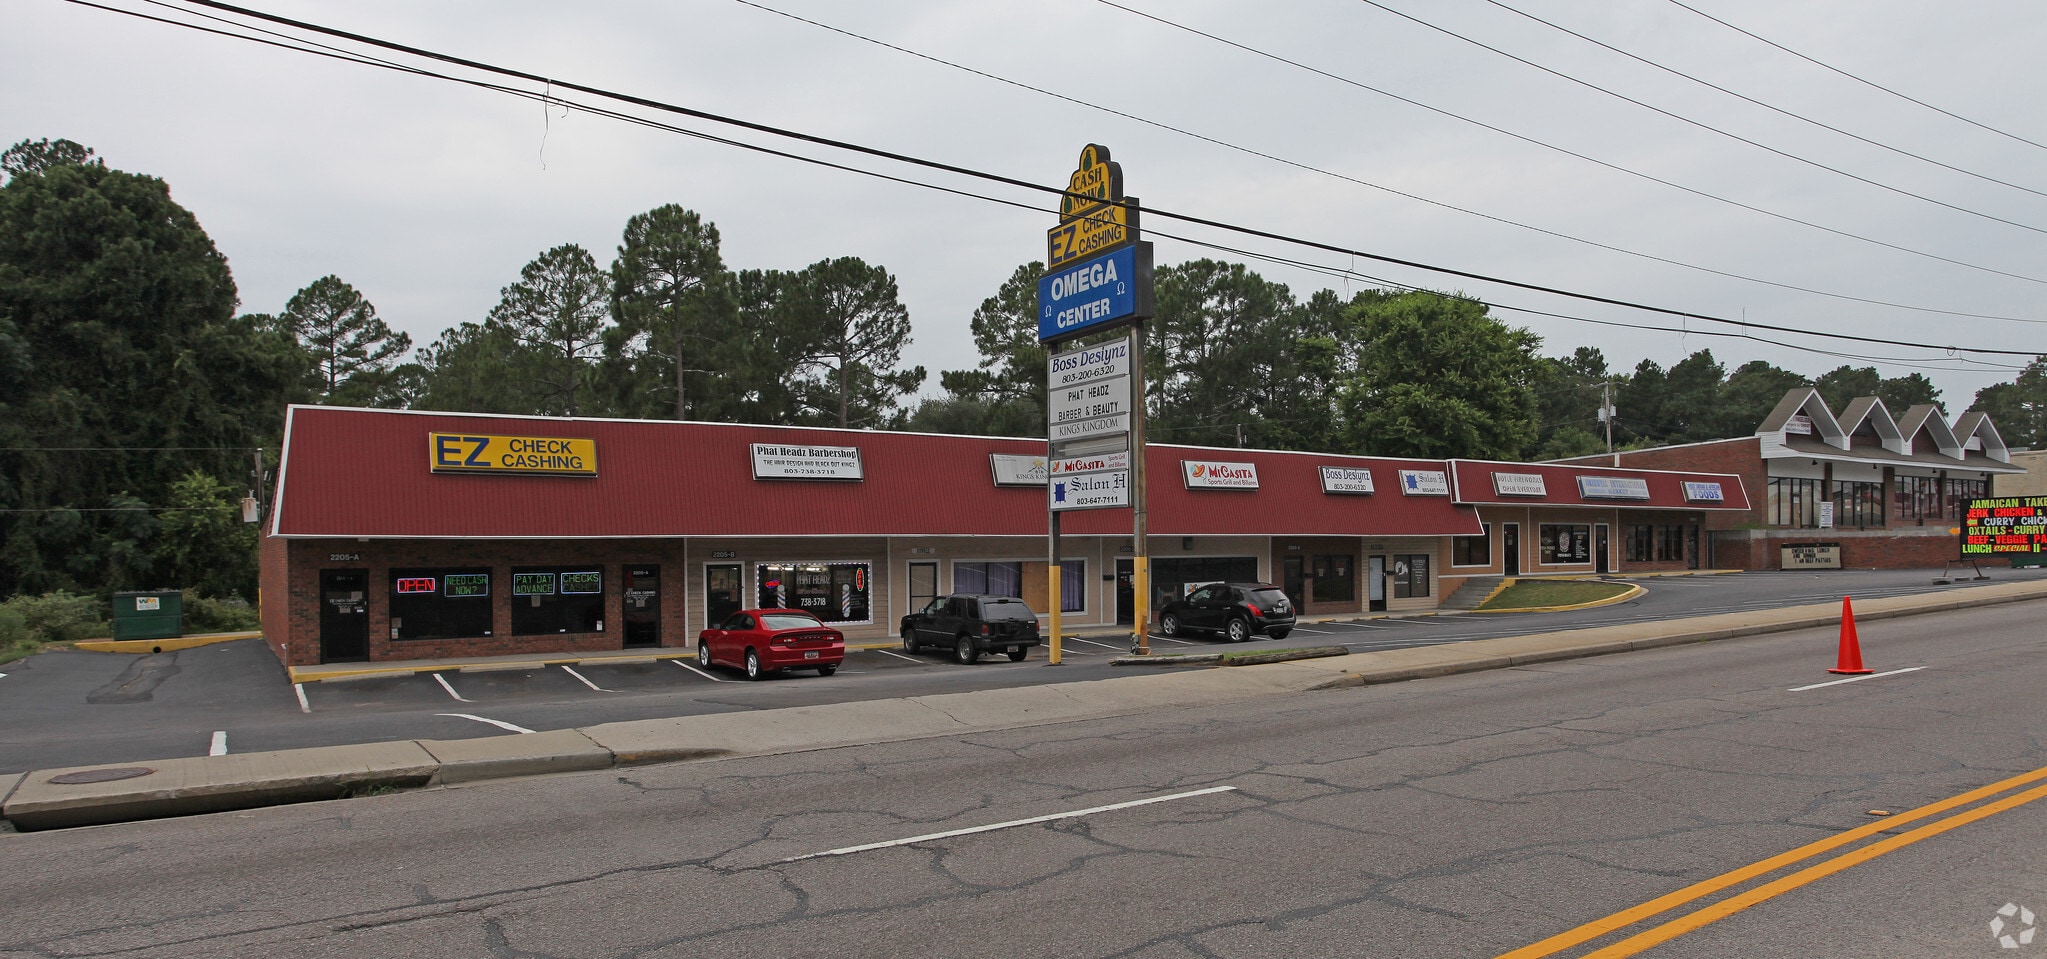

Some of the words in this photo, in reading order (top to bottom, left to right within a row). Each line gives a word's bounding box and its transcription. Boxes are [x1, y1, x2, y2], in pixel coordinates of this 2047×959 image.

[1073, 167, 1103, 191] CASH
[1072, 186, 1098, 211] NOW
[1082, 206, 1117, 234] CHECK
[1050, 225, 1078, 265] EZ
[1079, 225, 1123, 254] CASHING
[1051, 259, 1118, 302] OMEGA
[1057, 297, 1111, 329] CENTER
[1052, 357, 1077, 374] Boss
[1062, 364, 1115, 383] 803-200-6320
[1068, 389, 1084, 402] PHAT
[1088, 385, 1110, 399] HEADZ
[1058, 408, 1082, 421] BARBER
[1085, 406, 1090, 416] &
[1092, 401, 1119, 416] BEAUTY
[1059, 423, 1080, 437] KINGS
[1082, 417, 1119, 433] KINGDOM
[437, 436, 491, 466] EZ
[509, 439, 573, 454] CHECK
[757, 446, 778, 456] Phat
[780, 447, 807, 457] Headz
[809, 448, 857, 459] Barbershop
[501, 454, 583, 469] CASHING
[1325, 469, 1343, 480] Boss
[1068, 476, 1109, 495] Salon
[1076, 496, 1119, 505] 803-647-7111
[1693, 490, 1720, 499] FOODS
[1970, 498, 2019, 509] JAMAICAN
[1967, 508, 1989, 518] JERK
[1994, 507, 2034, 517] CHICKEN
[1984, 517, 2015, 526] CURRY
[1962, 544, 1992, 554] LUNCH
[1993, 544, 2031, 552] SPECIAL
[330, 553, 360, 561] 2205-A
[397, 579, 435, 593] OPEN
[447, 576, 467, 585] NEED
[468, 576, 488, 585] CASH
[516, 575, 533, 584] PAY
[536, 575, 553, 584] DAY
[562, 574, 599, 583] CHECKS
[516, 584, 553, 593] ADVANCE
